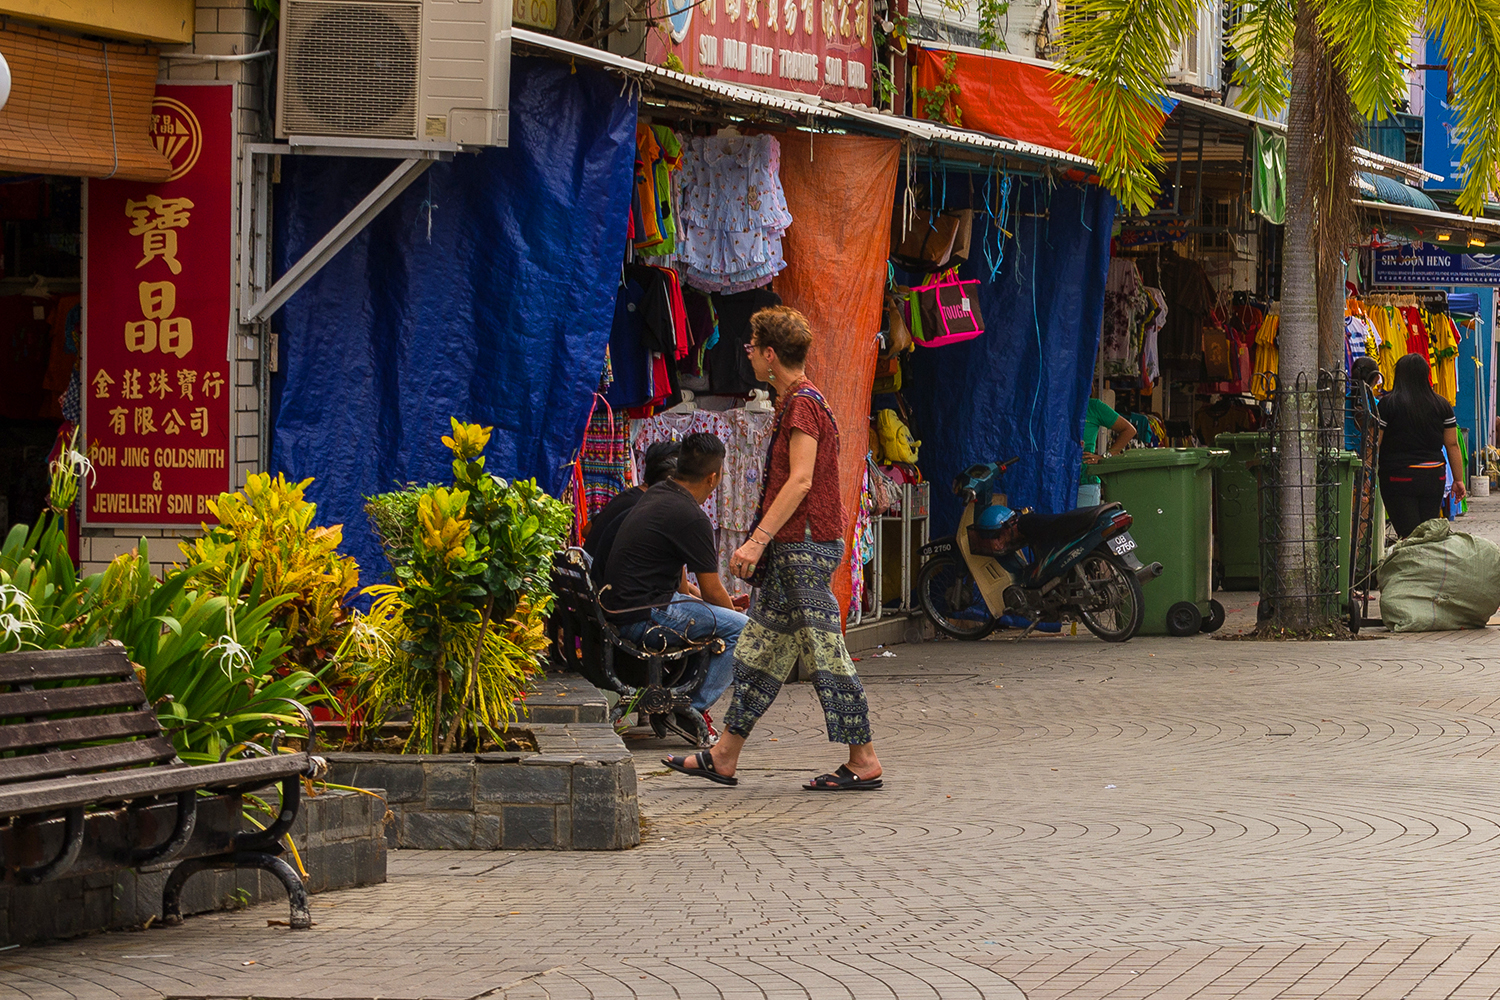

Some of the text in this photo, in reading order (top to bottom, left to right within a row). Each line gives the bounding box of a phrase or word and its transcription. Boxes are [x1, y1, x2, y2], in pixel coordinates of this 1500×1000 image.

[699, 34, 718, 66] SIN
[722, 37, 747, 71] NAM
[751, 43, 773, 76] FATT
[779, 48, 818, 82] TRADING
[1381, 255, 1397, 266] SIN
[1426, 256, 1451, 267] HENG
[124, 194, 194, 360] 寶晶
[91, 368, 225, 401] 金莊珠寶行
[108, 405, 210, 438] 有限公司
[91, 447, 225, 468] POH JING GOLDSMITH
[152, 471, 163, 491] &
[93, 494, 163, 514] JEWELLERY
[167, 494, 193, 514] SDN
